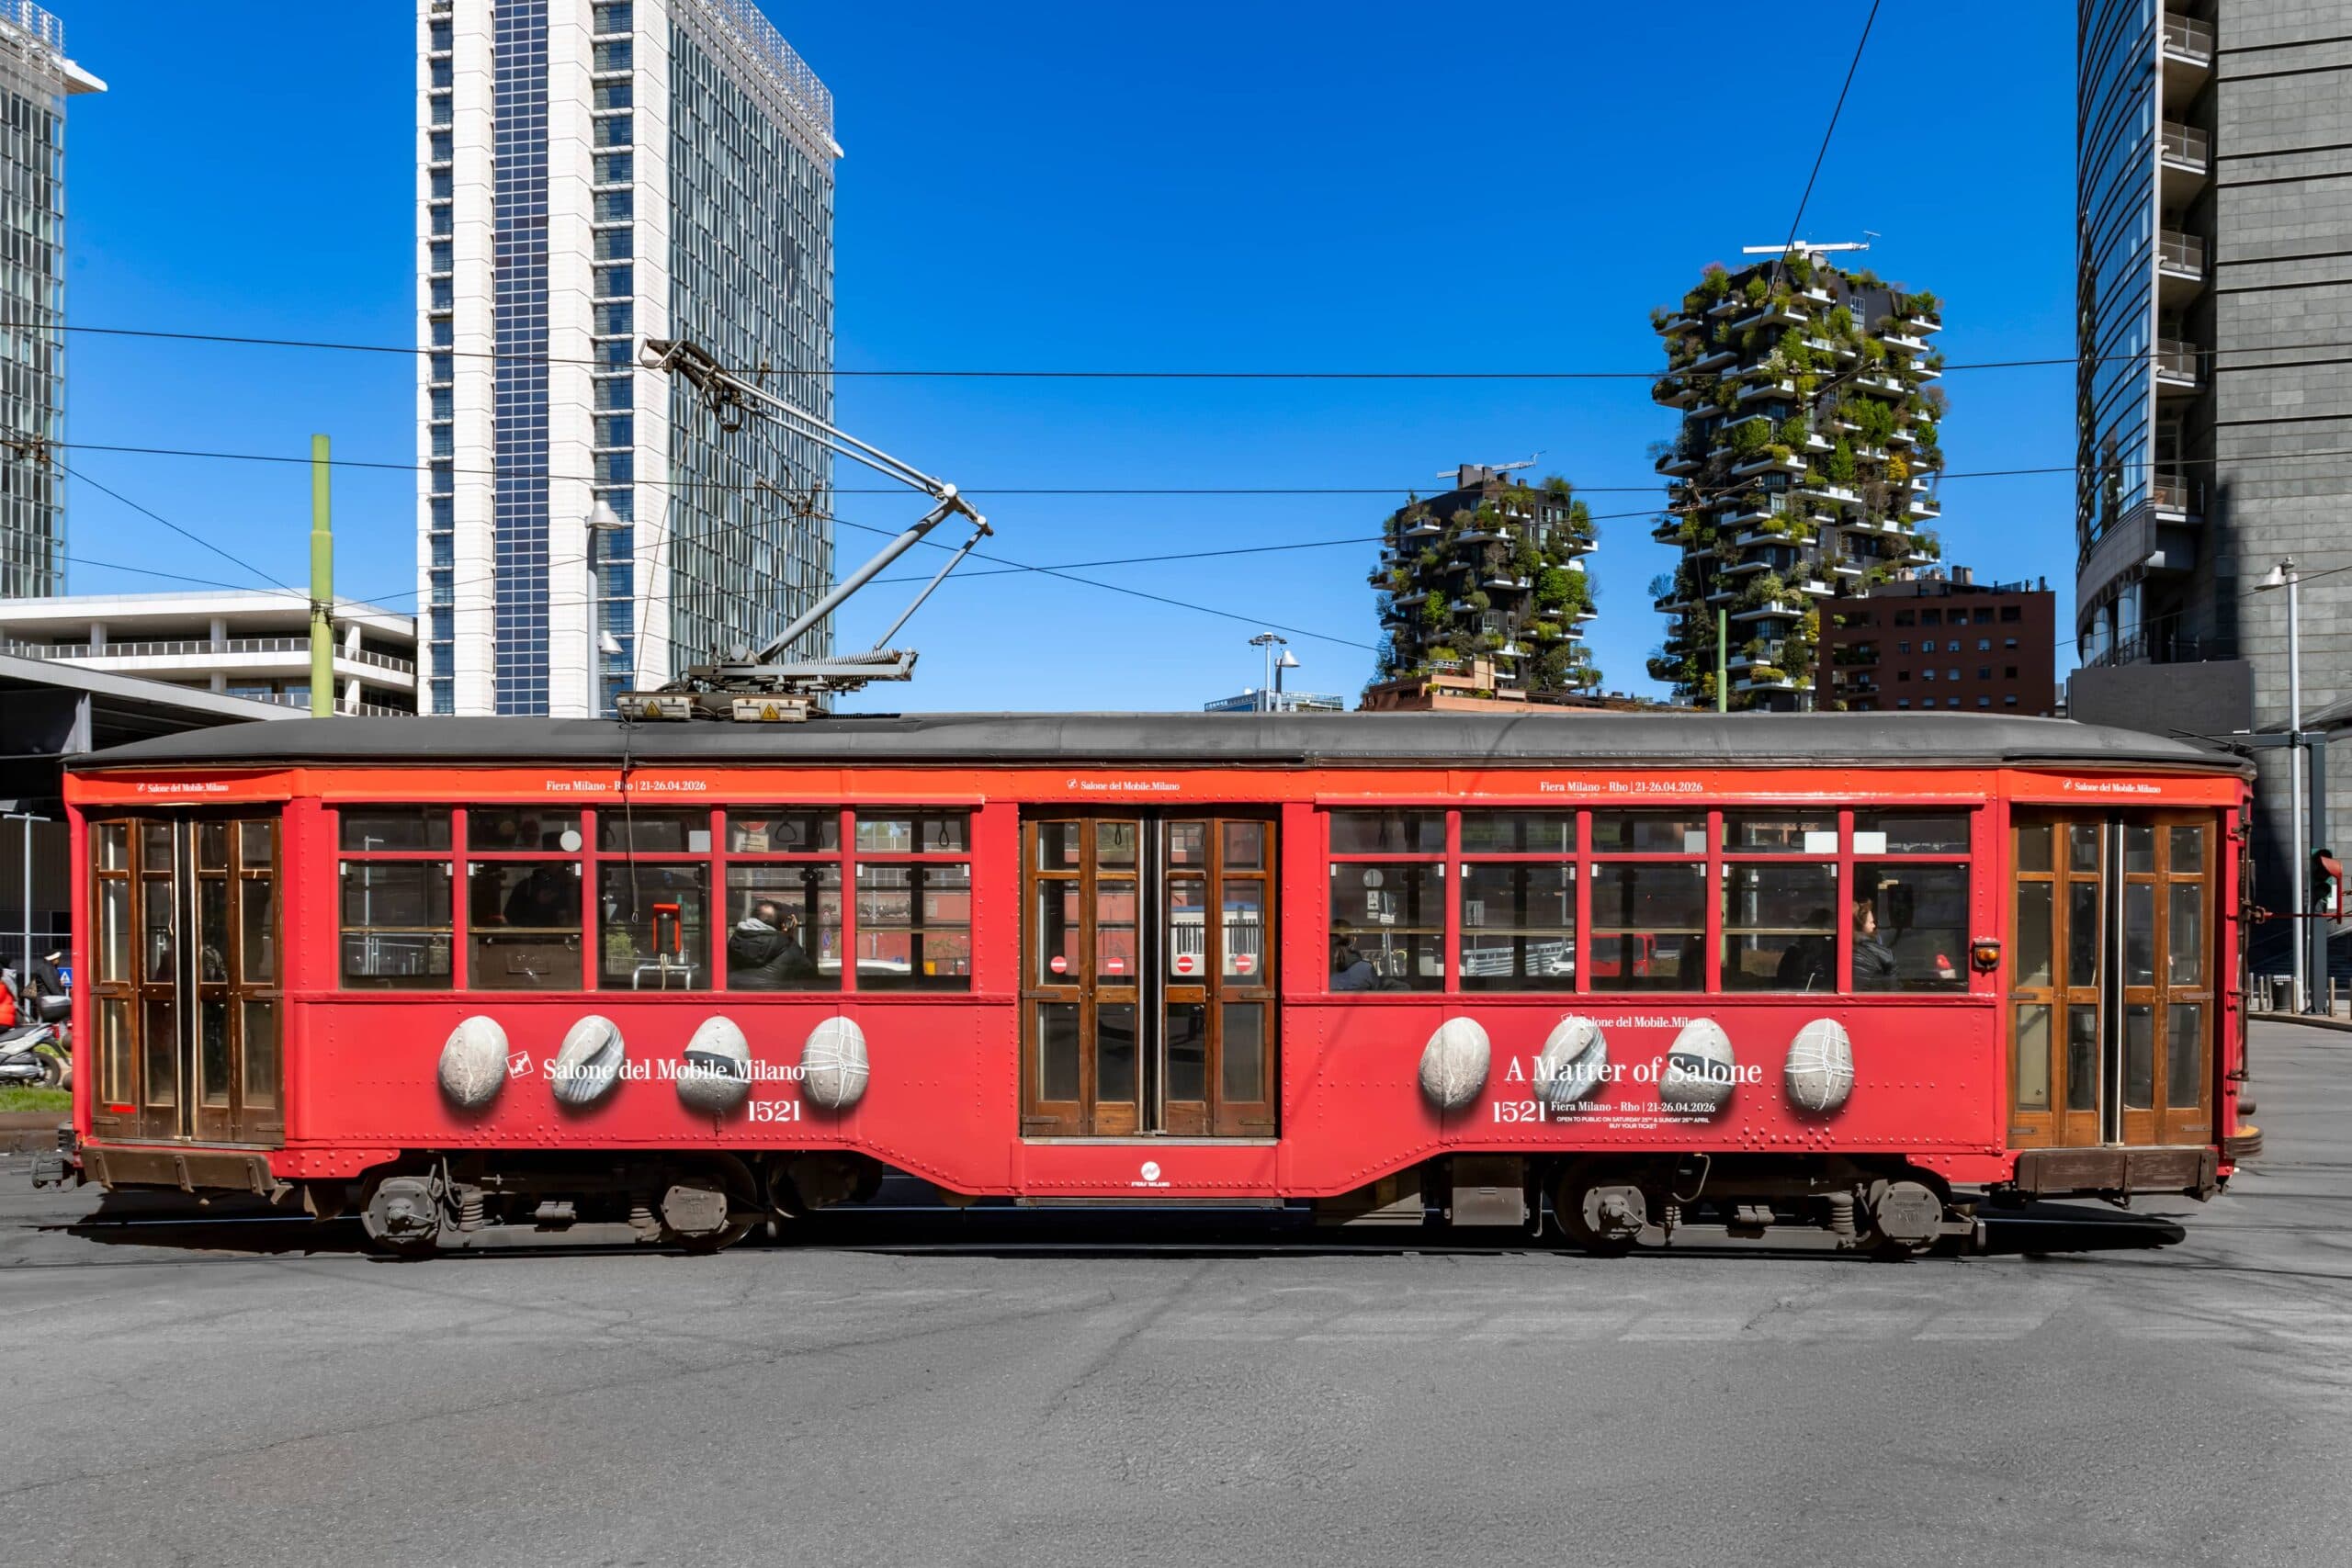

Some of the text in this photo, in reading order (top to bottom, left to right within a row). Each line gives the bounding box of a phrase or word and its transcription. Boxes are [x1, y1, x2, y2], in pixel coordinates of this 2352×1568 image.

[148, 783, 170, 793] Salone
[170, 783, 181, 792] del
[546, 780, 570, 791] Fiera
[572, 780, 605, 791] Milano
[614, 781, 633, 791] Ro
[640, 780, 707, 791] 21-26.04.2026
[1080, 780, 1181, 791] Salone del Mobile.Milano
[1540, 781, 1565, 792] Fiera
[1566, 781, 1600, 792] Milano
[1609, 781, 1628, 792] Rho
[1634, 781, 1703, 792] 21-26.04.2026
[2074, 782, 2099, 792] Salone
[2099, 783, 2111, 792] del
[1579, 1015, 1708, 1028] Salone del Mobile.Milano
[543, 1058, 806, 1081] Salone del Mobile.Milano
[1504, 1055, 1763, 1083] A Matter of Salone
[748, 1100, 800, 1122] 1521
[1492, 1100, 1546, 1123] 1521
[1550, 1101, 1576, 1111] Fiera
[1577, 1101, 1611, 1111] Milano
[1620, 1101, 1640, 1111] Rho
[1647, 1101, 1716, 1113] 21-26.04.2026
